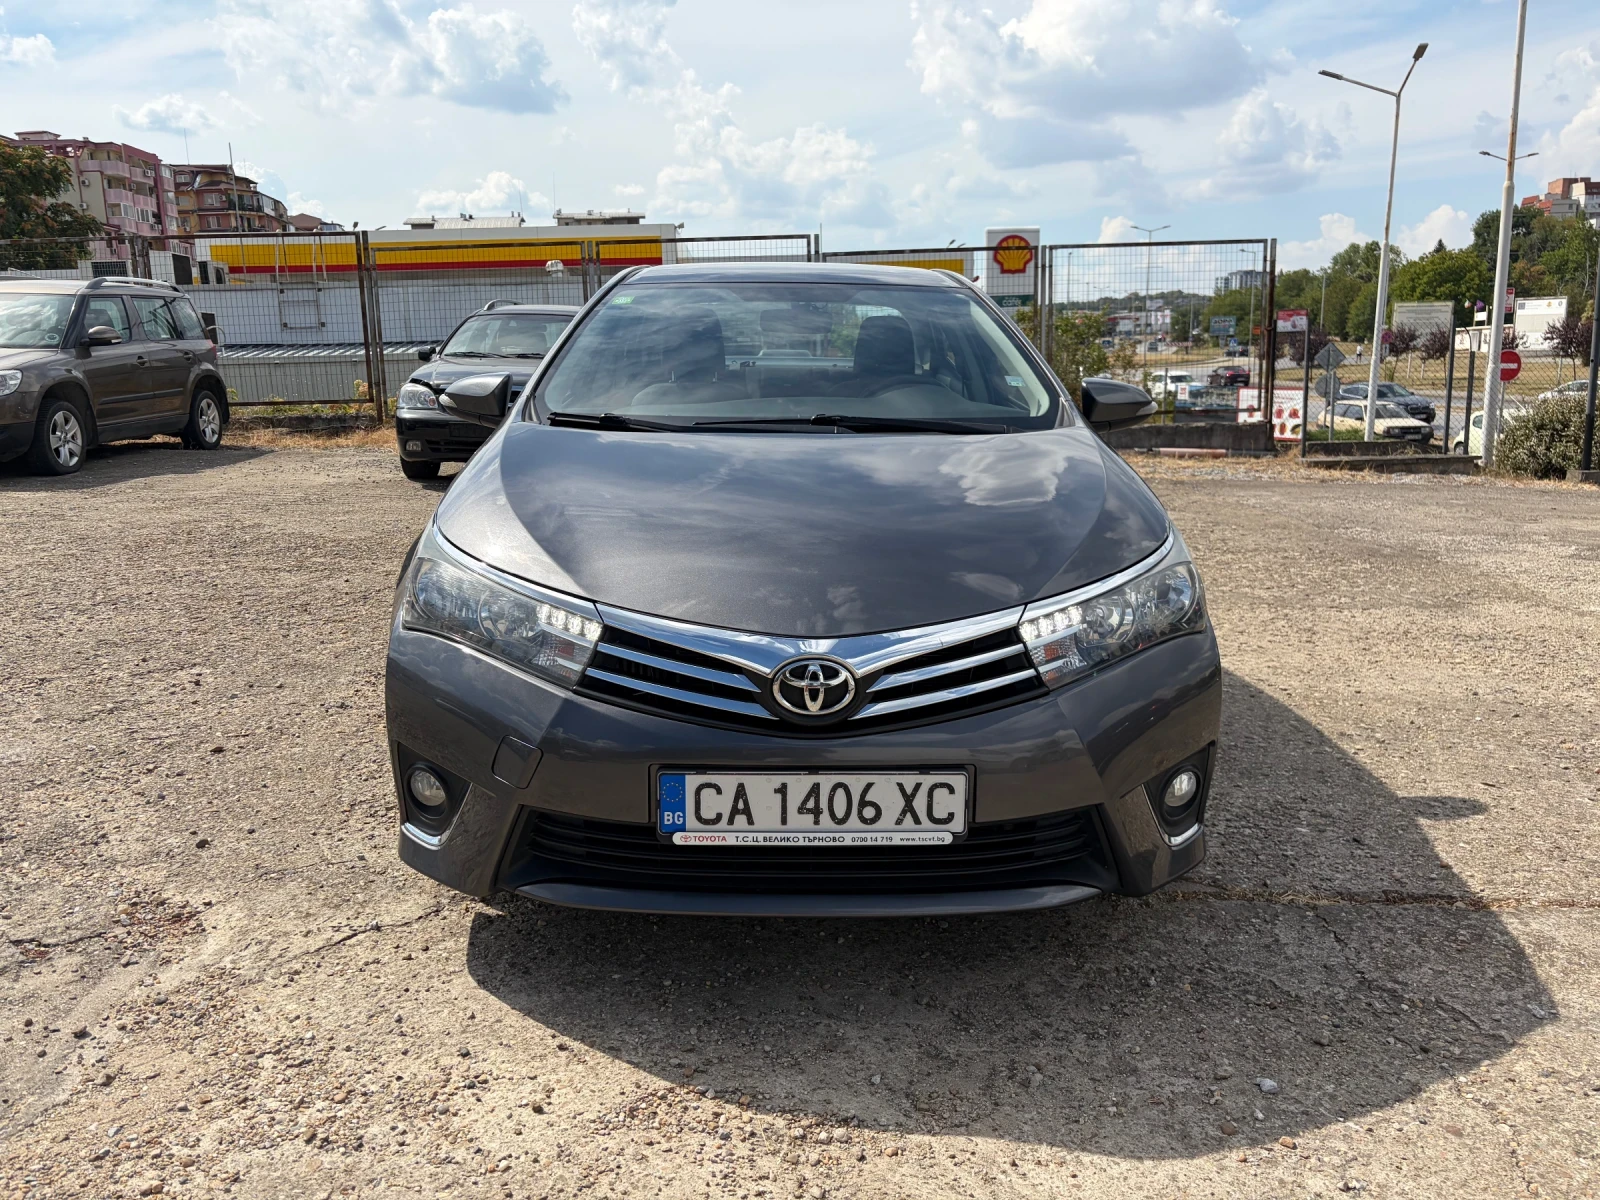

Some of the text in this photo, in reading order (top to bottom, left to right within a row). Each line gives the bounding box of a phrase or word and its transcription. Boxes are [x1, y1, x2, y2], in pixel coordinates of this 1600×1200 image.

[694, 782, 956, 826] CA 1406 XC
[663, 811, 684, 825] BG
[693, 835, 727, 843] TOYOTA
[763, 835, 800, 843] ВЕЛИКО
[802, 835, 845, 843] ТЪРНОВО
